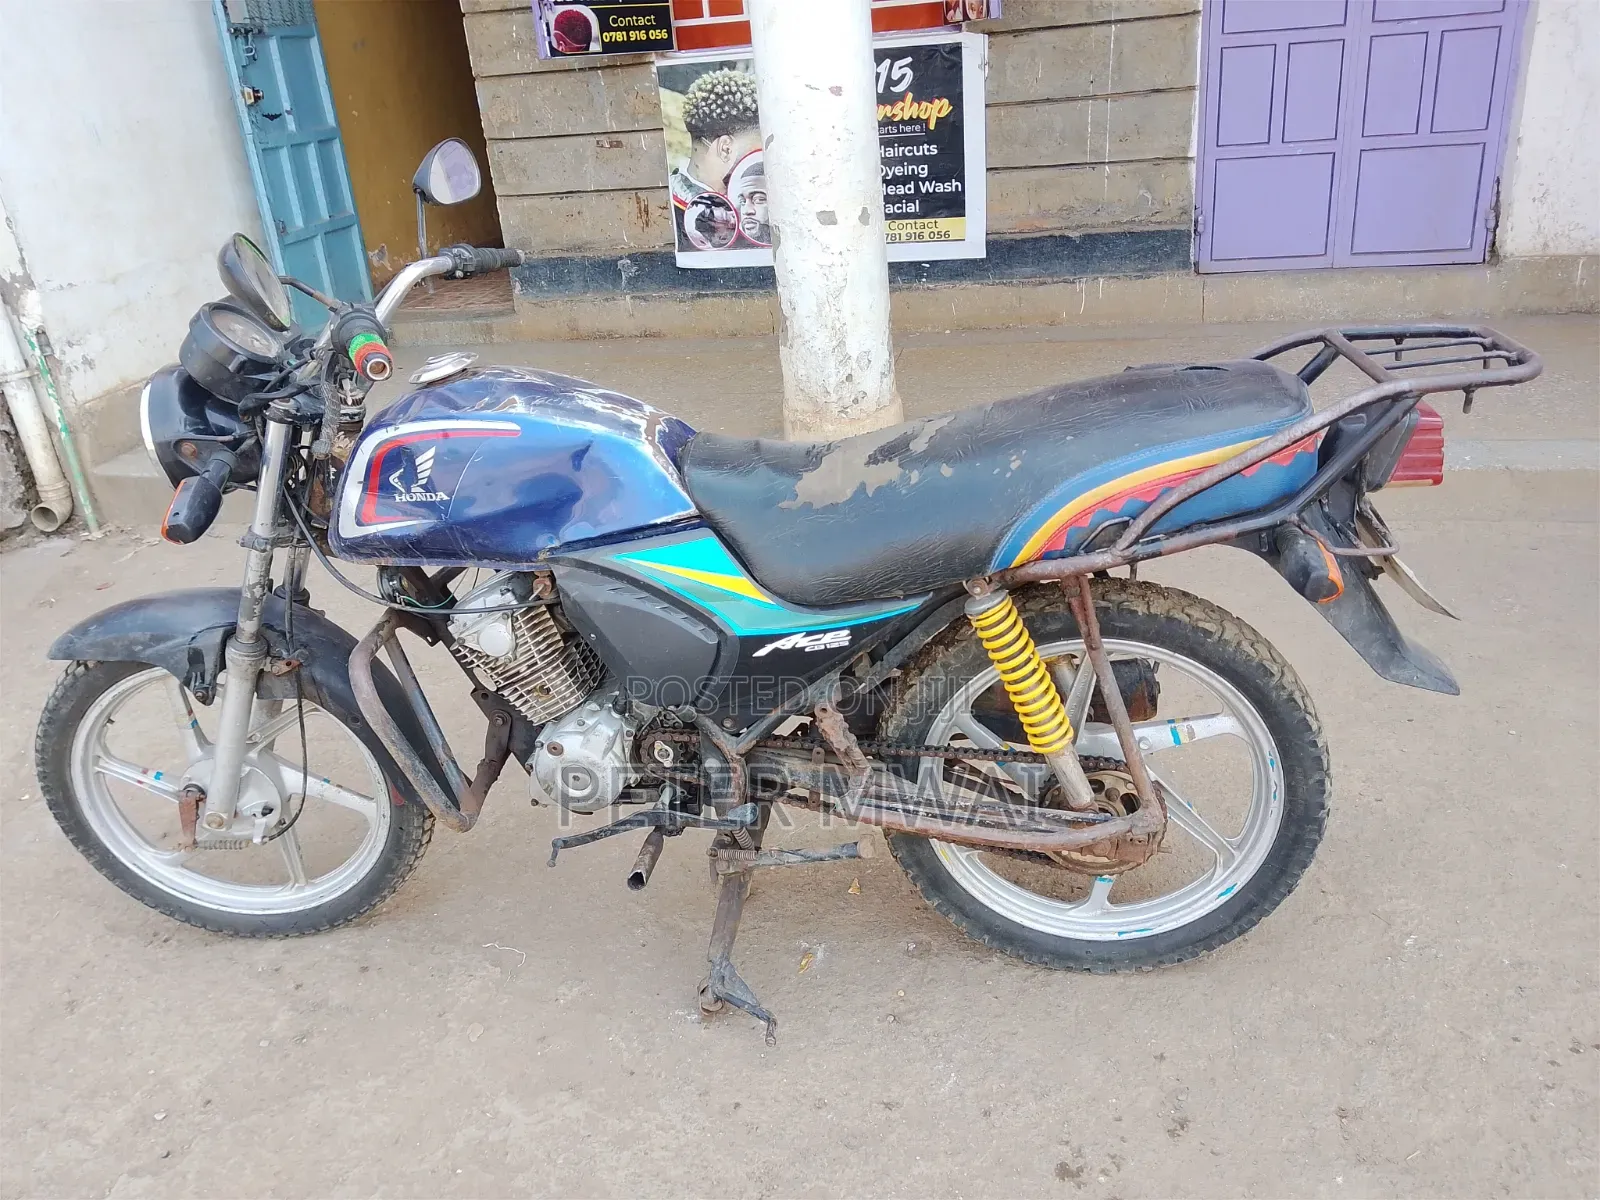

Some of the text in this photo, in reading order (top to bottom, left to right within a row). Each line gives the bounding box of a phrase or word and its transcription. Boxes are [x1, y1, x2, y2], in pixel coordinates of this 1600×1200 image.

[609, 14, 656, 27] Contact
[602, 29, 668, 43] 0781 916 056
[874, 57, 914, 94] 15
[876, 90, 953, 131] rshop
[919, 179, 962, 194] Wash
[883, 199, 920, 214] acial
[888, 219, 939, 231] Contact
[905, 231, 925, 241] 916
[928, 230, 951, 240] 056
[393, 491, 450, 503] HONDA
